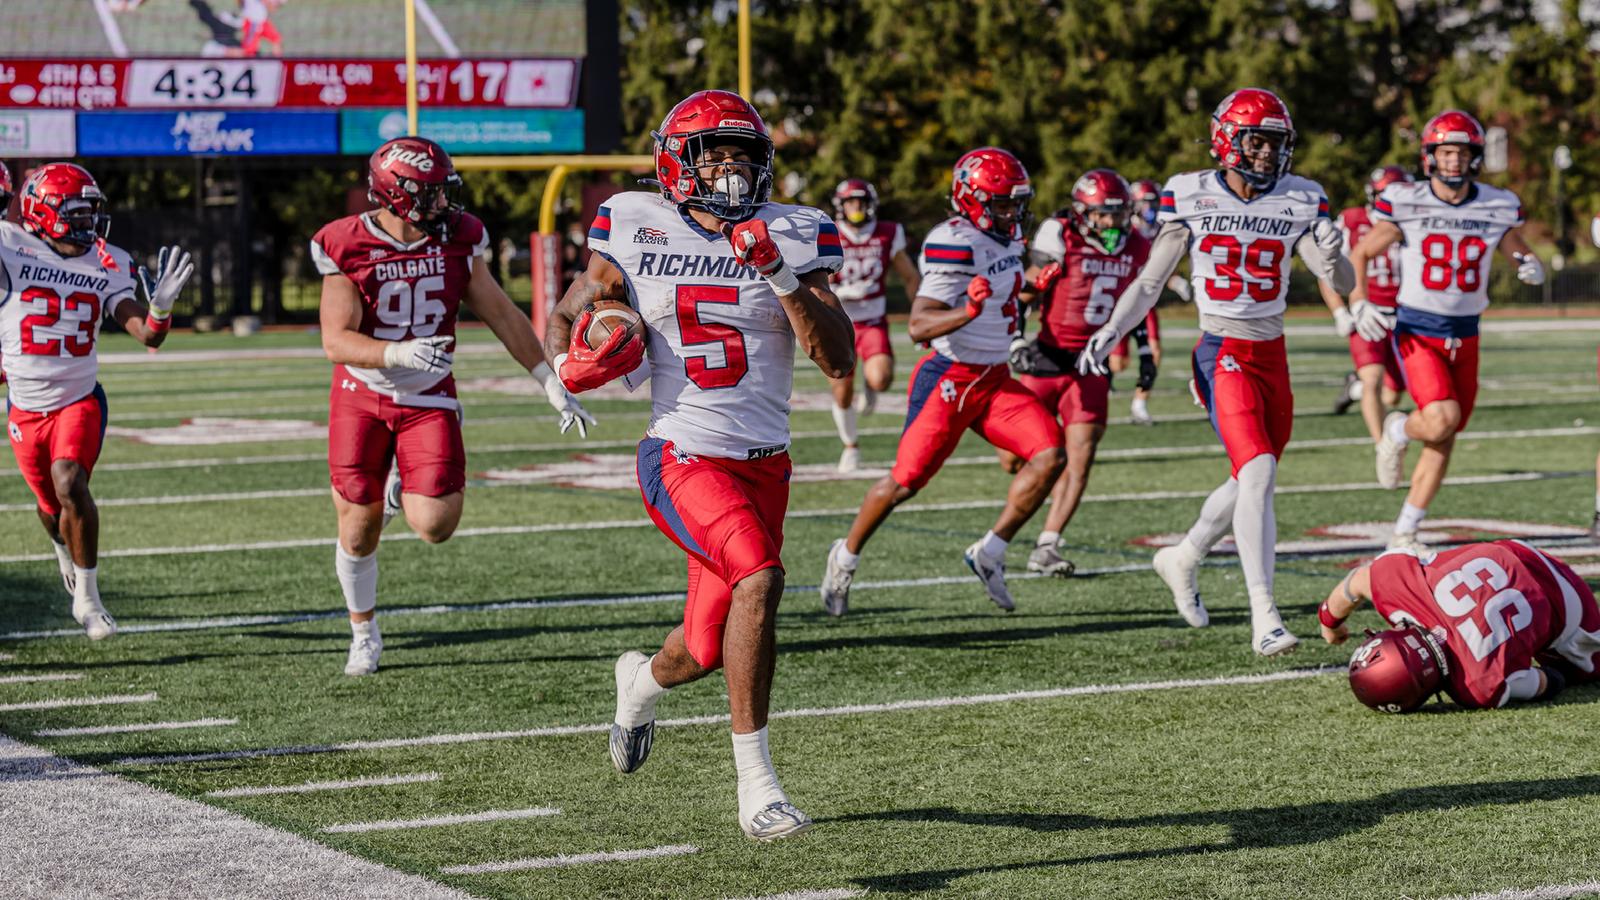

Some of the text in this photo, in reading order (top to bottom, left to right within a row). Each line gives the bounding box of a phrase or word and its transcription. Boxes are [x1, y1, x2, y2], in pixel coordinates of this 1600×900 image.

[154, 67, 257, 99] 4:34
[294, 63, 373, 85] BALL ON
[450, 61, 507, 102] 17
[724, 120, 752, 129] Riddell
[1200, 215, 1294, 236] RICHMOND
[19, 264, 109, 292] RICHMOND
[375, 256, 446, 281] COLGATE
[637, 252, 770, 281] RICHMON
[1199, 233, 1285, 303] 39
[1421, 233, 1488, 293] 88
[20, 285, 101, 358] 23
[373, 275, 447, 340] 96
[1084, 276, 1119, 326] 6
[676, 284, 749, 390] 5
[1434, 557, 1533, 662] 53
